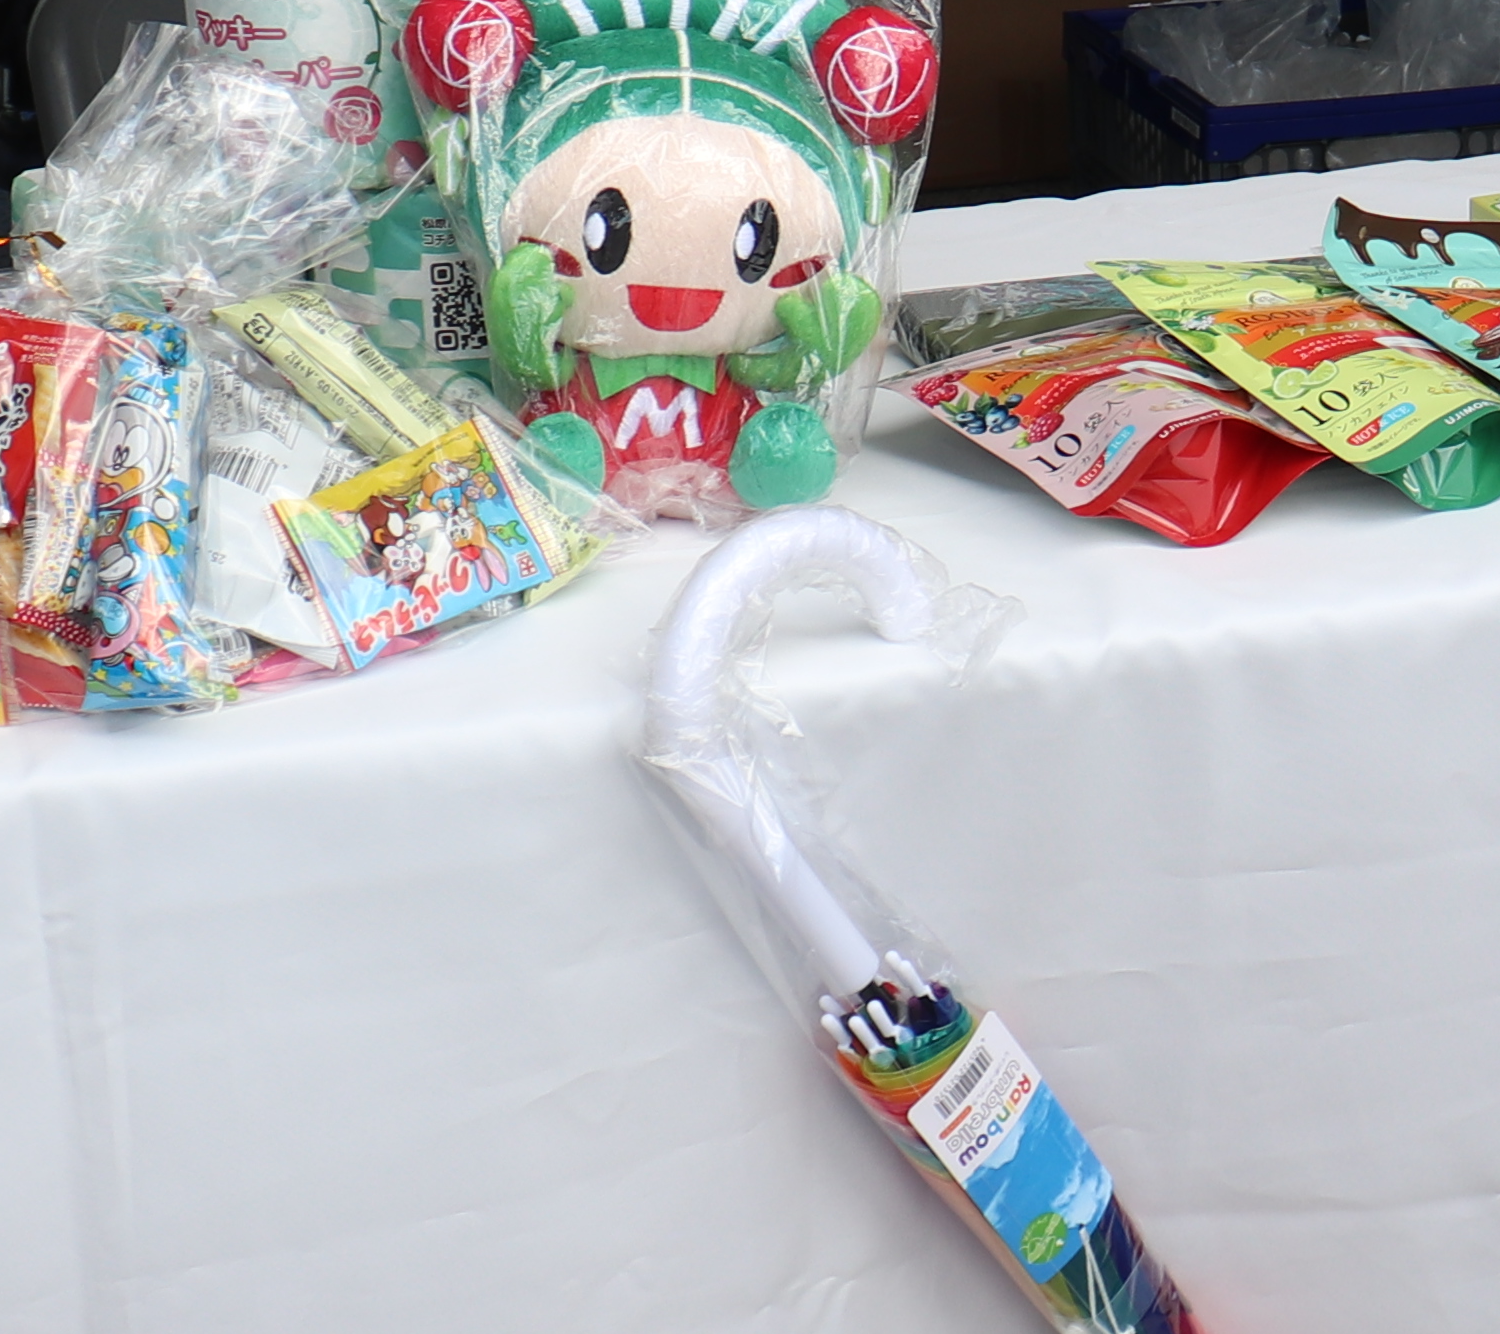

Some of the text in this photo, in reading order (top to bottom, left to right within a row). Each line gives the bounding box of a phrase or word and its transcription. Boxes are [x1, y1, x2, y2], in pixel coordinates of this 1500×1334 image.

[195, 9, 287, 51] マッキー
[614, 386, 705, 451] M
[1326, 384, 1410, 439] ノンカフェイン
[1351, 422, 1378, 446] HOT
[1387, 404, 1411, 422] ICE
[1078, 460, 1105, 487] HOT
[349, 554, 471, 654] クッピーラムネ
[946, 1059, 1021, 1154] umbrella
[958, 1073, 1033, 1167] Rainbow
